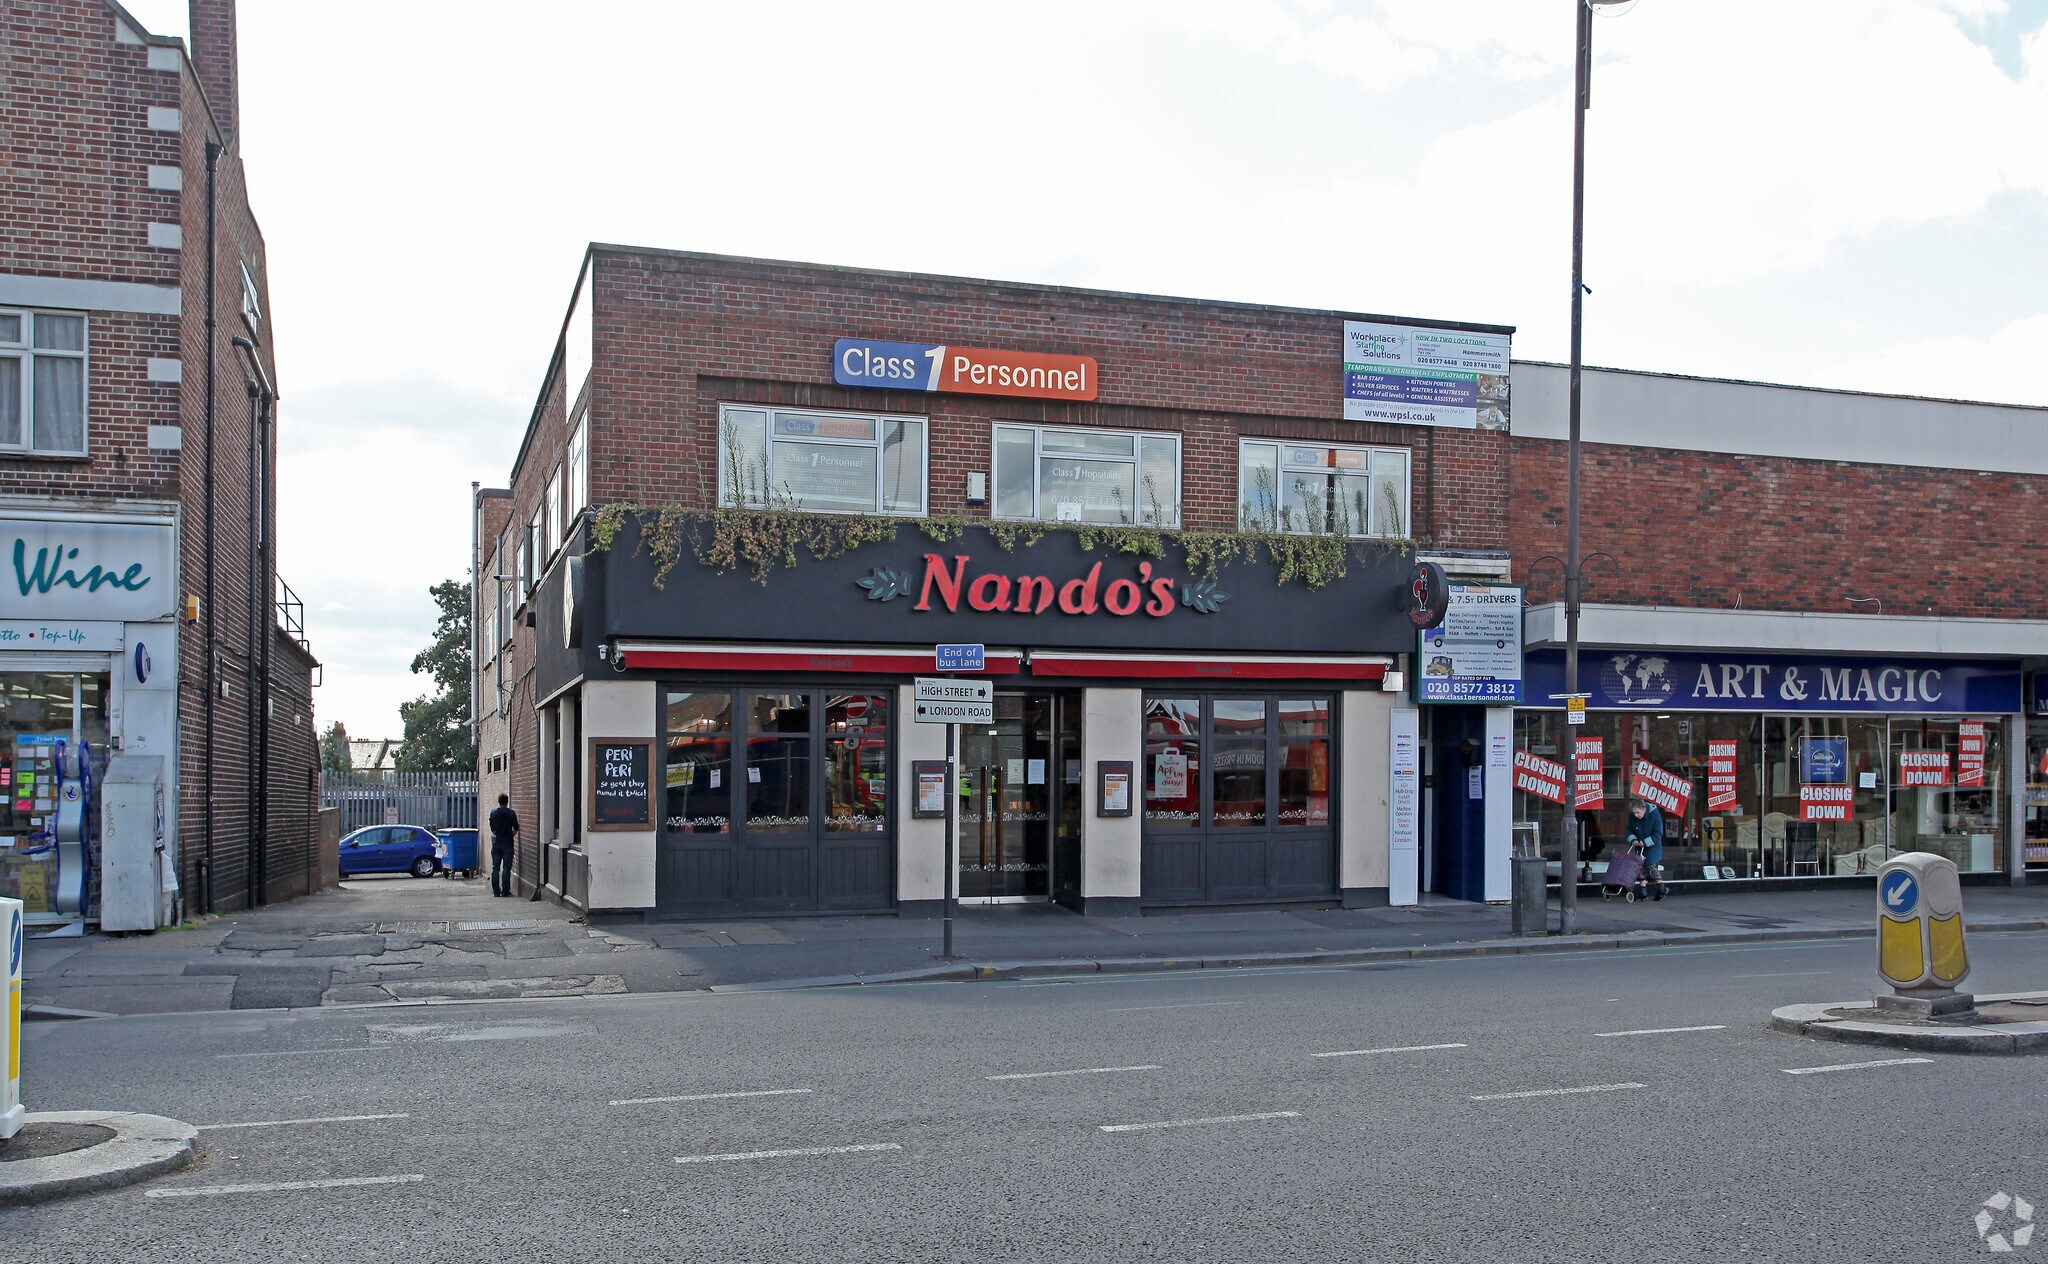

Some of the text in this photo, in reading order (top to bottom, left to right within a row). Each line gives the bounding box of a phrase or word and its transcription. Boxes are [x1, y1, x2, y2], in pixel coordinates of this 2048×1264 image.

[1350, 332, 1396, 344] Workplace
[1454, 338, 1487, 346] LOCATIONS
[1356, 342, 1385, 351] Staffing
[1363, 350, 1400, 360] Solutions
[1462, 349, 1500, 358] Hammersmith
[842, 346, 1086, 392] Class 1 Personnel
[1348, 364, 1387, 372] TEMPORARY
[1392, 368, 1430, 376] PERMANENT
[1432, 371, 1474, 380] EMPLOYMENT
[1364, 410, 1436, 421] www.wpsl.co.uk
[788, 420, 810, 431] Class
[787, 453, 809, 463] Class
[820, 456, 863, 468] Personnel
[1052, 467, 1073, 477] Class
[14, 538, 151, 596] Wine
[913, 553, 1176, 617] Nando's
[1477, 595, 1516, 604] DRIVERS
[40, 628, 86, 645] Top-Up
[944, 648, 976, 656] End of
[940, 658, 981, 666] bus lane
[1428, 683, 1515, 694] 020 8577 3812
[1692, 663, 1942, 702] ART & MAGIC
[922, 687, 974, 696] HIGH STREET
[930, 706, 990, 716] LONDON ROAD
[1960, 724, 1983, 736] CLOSING
[1709, 744, 1736, 757] CLOSING
[1962, 740, 1980, 751] DOWN
[1578, 759, 1598, 771] DOWN
[1900, 754, 1949, 767] CLOSING
[1712, 761, 1732, 773] DOWN
[610, 780, 626, 788] good
[629, 779, 645, 788] they
[1637, 760, 1691, 797] CLOSING
[1907, 771, 1942, 784] DOWN
[1517, 772, 1560, 799] DOWN
[1638, 781, 1678, 811] DOWN
[1800, 787, 1852, 801] CLOSING
[1807, 806, 1844, 818] DOWN
